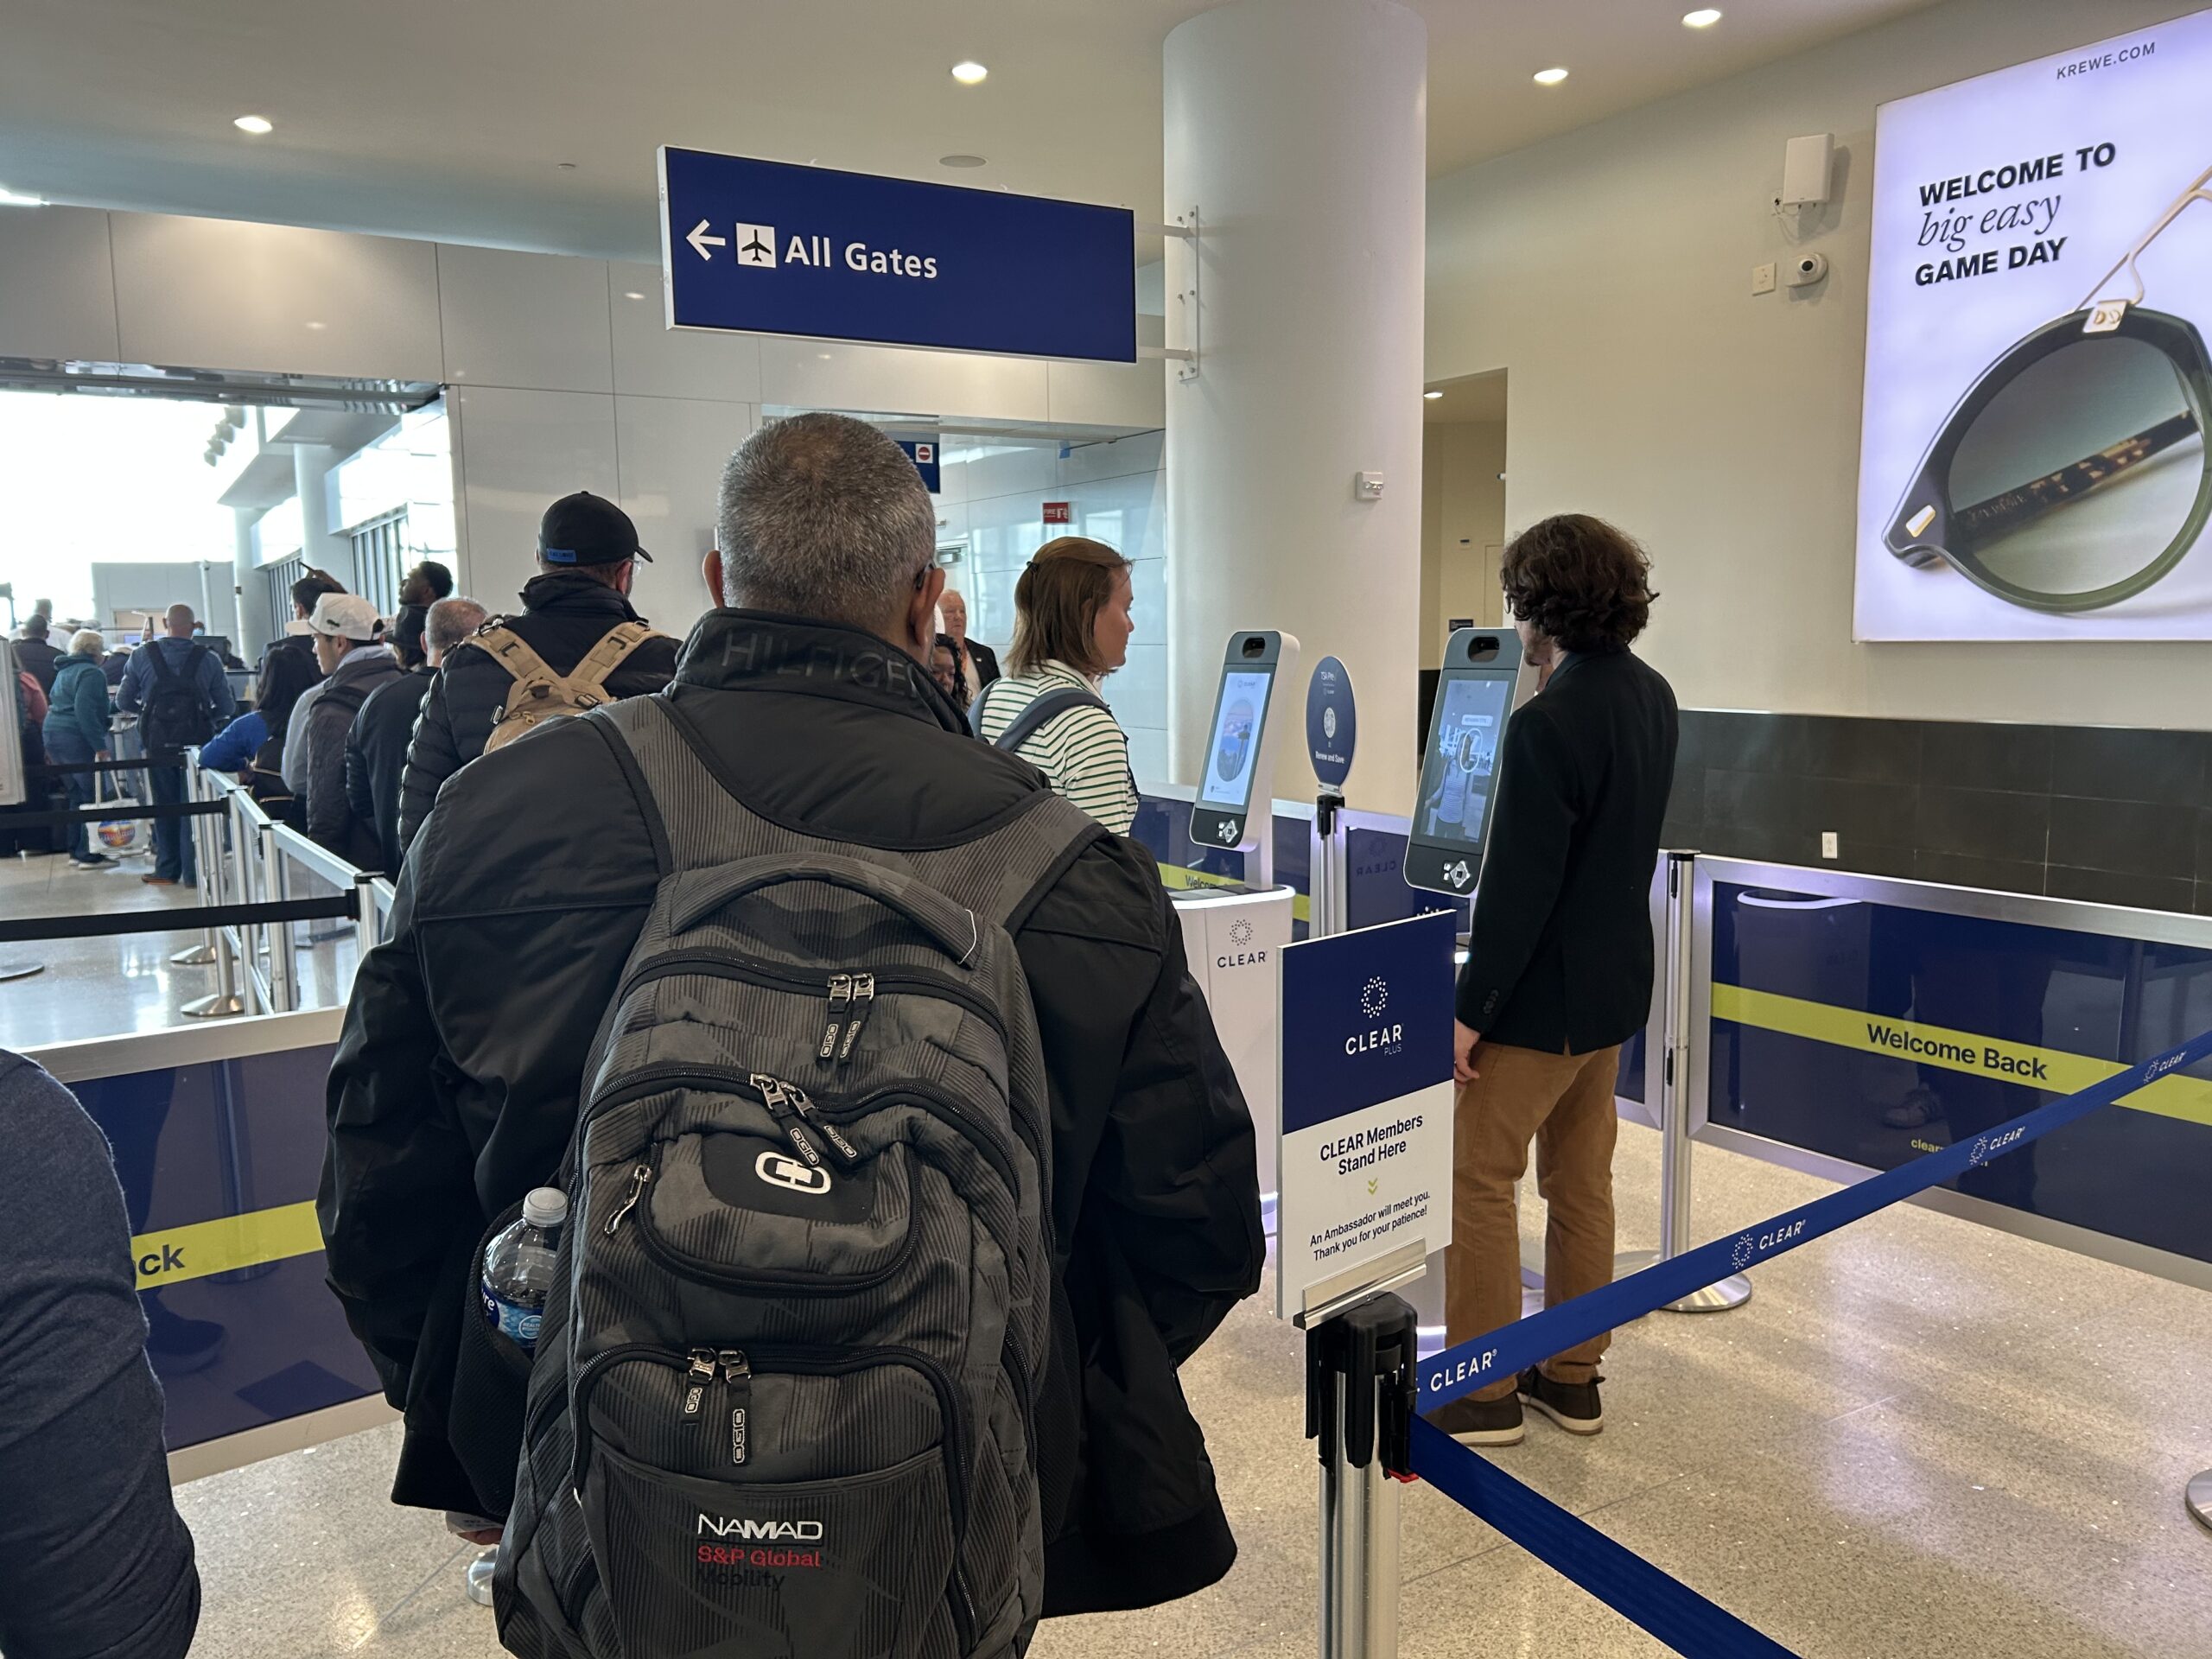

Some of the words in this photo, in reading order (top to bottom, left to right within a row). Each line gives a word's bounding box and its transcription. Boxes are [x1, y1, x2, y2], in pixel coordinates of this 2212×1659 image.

[2056, 41, 2155, 79] KREWE.COM
[1919, 153, 2064, 207] WELCOME
[2075, 142, 2116, 172] TO
[1917, 207, 1974, 252] big
[1980, 194, 2062, 236] easy
[785, 235, 830, 268] All
[844, 242, 938, 278] Gates
[1915, 250, 1999, 286] GAME
[2008, 236, 2069, 270] DAY
[1315, 750, 1327, 760] Renew
[1335, 753, 1344, 764] Save
[1384, 1044, 1402, 1056] PLUS
[1866, 1023, 1976, 1065] Welcome
[1983, 1047, 2047, 1080] Back
[790, 1127, 819, 1166] OGIO
[1320, 1133, 1363, 1161] CLEAR
[1366, 1116, 1423, 1146] Members
[1338, 1148, 1376, 1175] Stand
[1378, 1141, 1407, 1161] Here
[1310, 1235, 1322, 1247] An
[1324, 1211, 1376, 1241] Ambassador
[1377, 1204, 1392, 1219] will
[1393, 1196, 1413, 1213] meet
[1414, 1191, 1431, 1207] you.
[1313, 1242, 1341, 1262] Thank
[1342, 1236, 1357, 1252] you
[1359, 1230, 1371, 1243] for
[1372, 1222, 1391, 1239] your
[1391, 1205, 1427, 1231] patience!
[134, 1243, 186, 1275] ck
[697, 1513, 823, 1540] NAMAD
[697, 1545, 745, 1565] S&P
[750, 1549, 821, 1567] Global
[698, 1568, 785, 1591] Mobility
